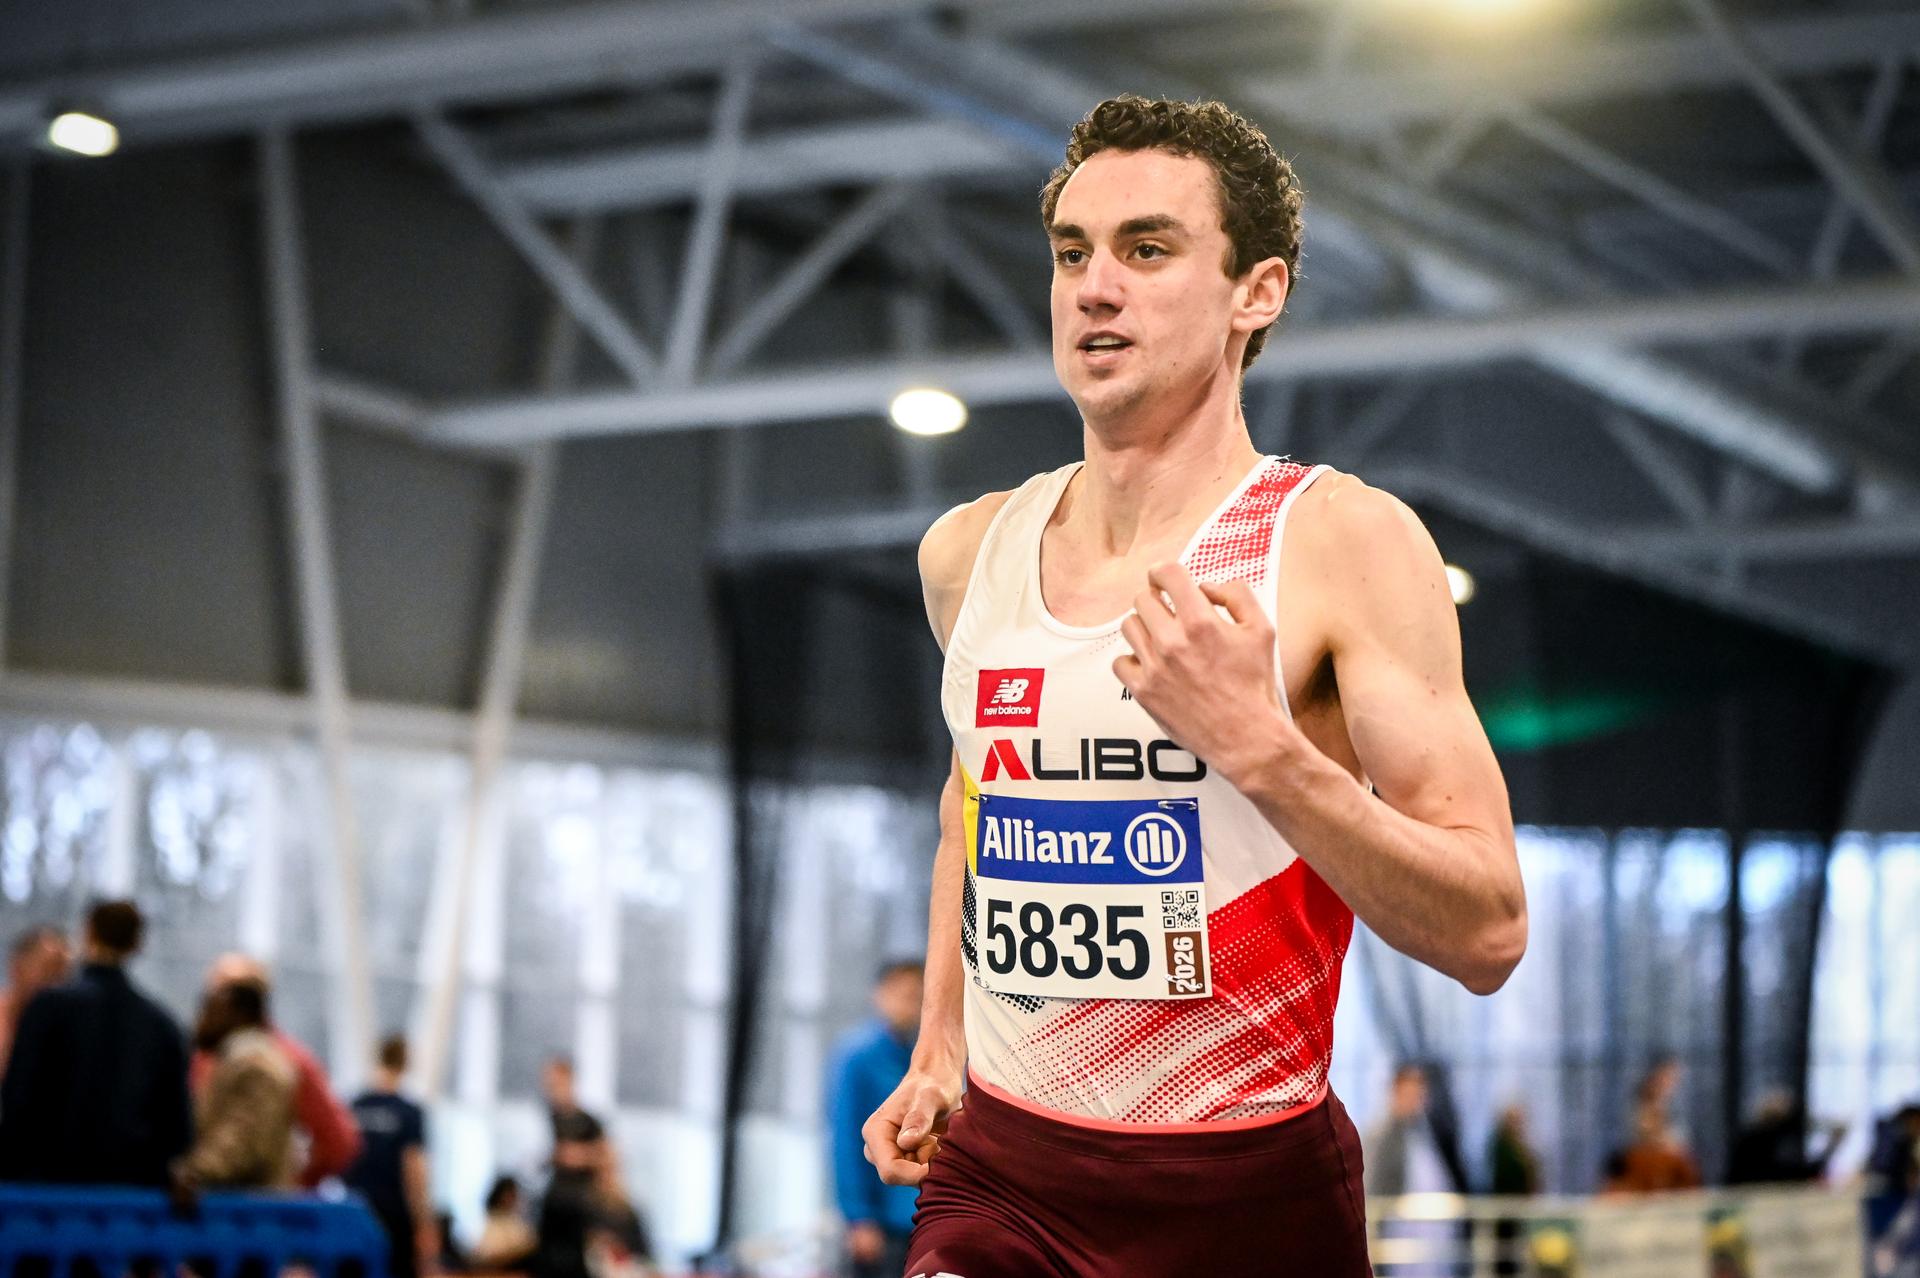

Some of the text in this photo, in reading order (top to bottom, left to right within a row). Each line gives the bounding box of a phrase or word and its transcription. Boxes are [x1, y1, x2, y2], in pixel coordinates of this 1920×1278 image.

[984, 705, 1032, 716] new balance
[991, 678, 1029, 704] NB
[981, 738, 1207, 782] ALIBO
[983, 816, 1114, 864] Allianz
[986, 898, 1150, 981] 5835
[1173, 936, 1197, 993] 2026
